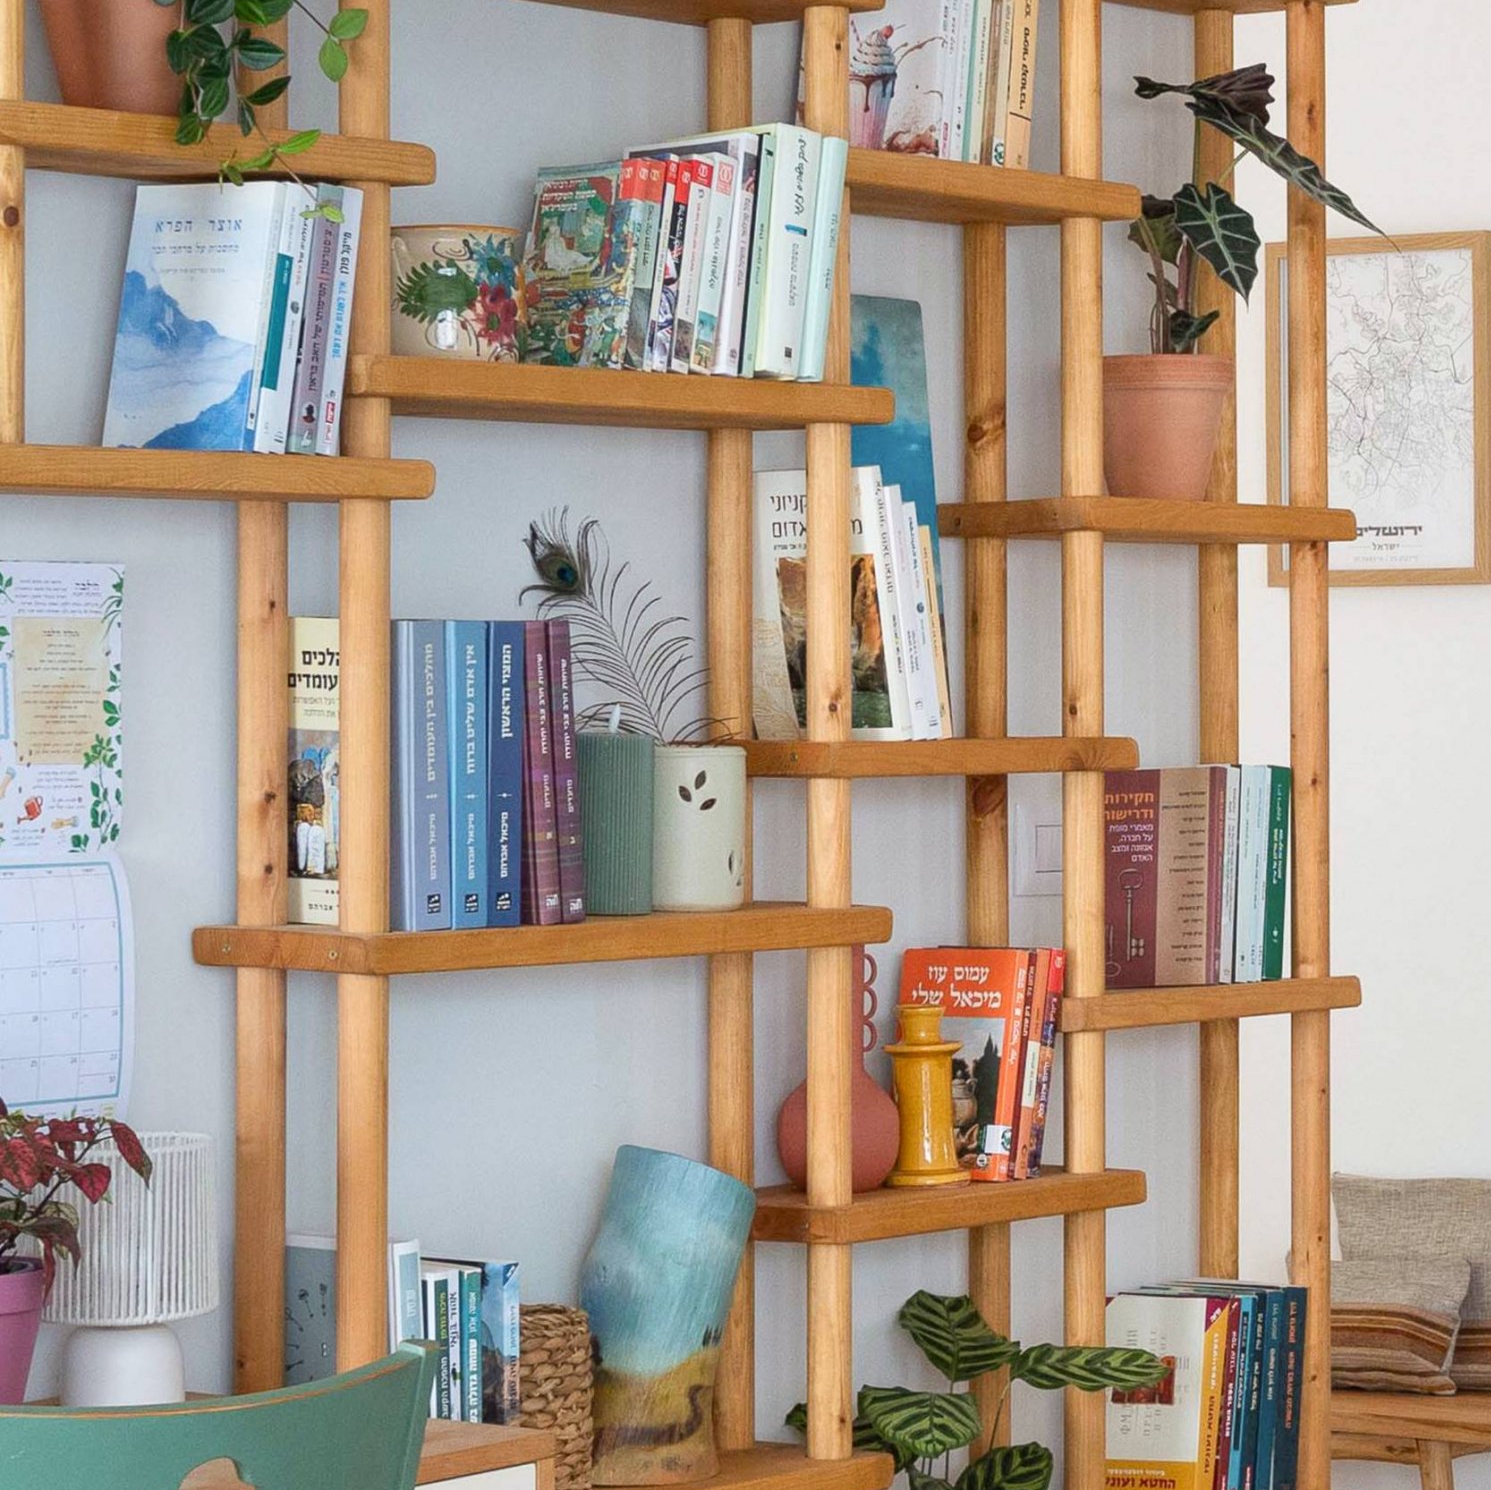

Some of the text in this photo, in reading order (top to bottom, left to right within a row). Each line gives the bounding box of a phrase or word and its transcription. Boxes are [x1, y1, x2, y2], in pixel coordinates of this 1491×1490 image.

[1019, 26, 1030, 110] סיפורי קנטרברי
[154, 219, 244, 233] אוצר הפרא
[339, 231, 352, 275] מייקל פולן
[312, 324, 323, 341] של
[311, 343, 322, 363] האב
[309, 364, 319, 392] בראון
[769, 492, 807, 514] קניוני
[877, 498, 886, 527] קניוני
[771, 520, 807, 538] אדום
[1371, 541, 1401, 551] ישראל
[287, 673, 339, 691] עומדים
[536, 653, 545, 685] שיחות
[560, 658, 569, 690] שיחות
[541, 726, 549, 755] יהודה
[564, 732, 572, 760] יהודה
[424, 643, 438, 881] מהלכים בין העומדים מיכאל אברהם
[464, 643, 477, 880] אין אדם שליט ברוח מיכאל אברהם
[499, 643, 514, 879] המצוי הראשון מיכאל אברהם
[543, 774, 551, 808] מועדים
[566, 779, 574, 814] מועדים
[1104, 792, 1154, 806] חקירות
[1142, 833, 1154, 842] על
[1131, 854, 1153, 862] האדם
[928, 965, 990, 985] עמוס עוז
[911, 982, 1002, 1009] מיכאל שלי
[1007, 966, 1026, 1066] עמוס עוז מיכאל שלי
[439, 1292, 448, 1315] מיכה
[449, 1291, 459, 1348] אהוד בנאי
[468, 1291, 479, 1424] אמונה אלון שמחה גדולה בש
[1267, 1370, 1275, 1386] לרוץ
[441, 1391, 450, 1419] הקשב
[1207, 1395, 1216, 1430] החטא
[1224, 1408, 1232, 1438] האדום
[1104, 1476, 1176, 1490] החטא ועונ
